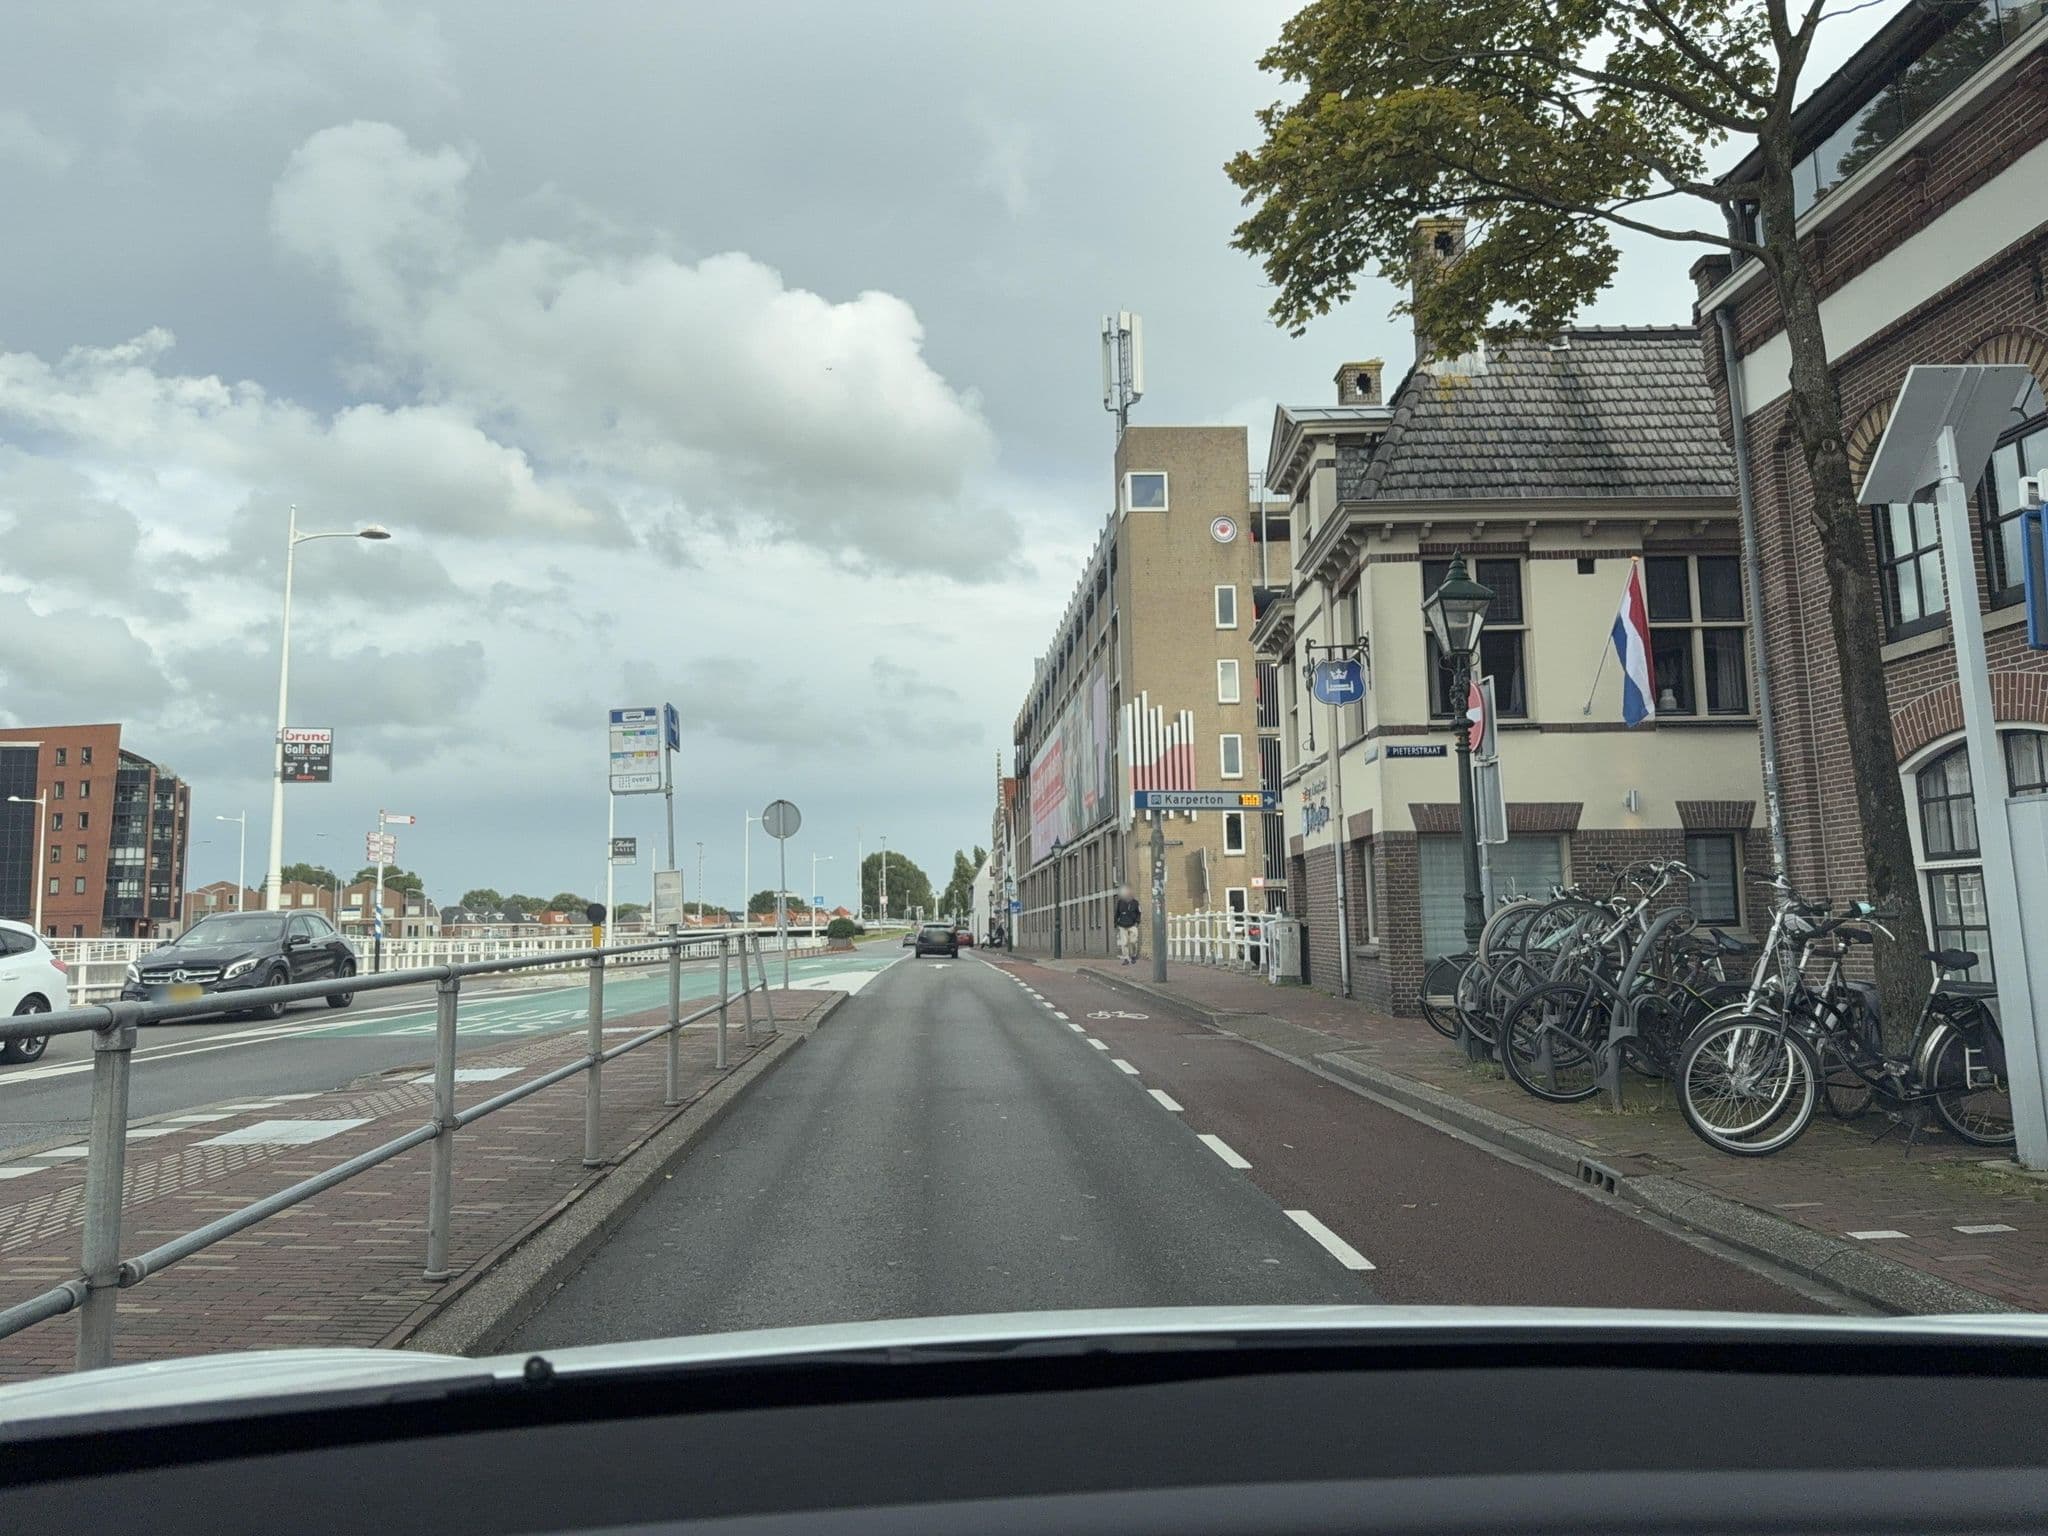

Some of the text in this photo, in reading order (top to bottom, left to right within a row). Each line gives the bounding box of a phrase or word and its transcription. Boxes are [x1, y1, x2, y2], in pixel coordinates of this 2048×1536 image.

[285, 744, 305, 754] Gall
[310, 744, 329, 755] Gall
[1392, 746, 1441, 756] PIETERSTRAAT
[1165, 794, 1224, 805] Karperton
